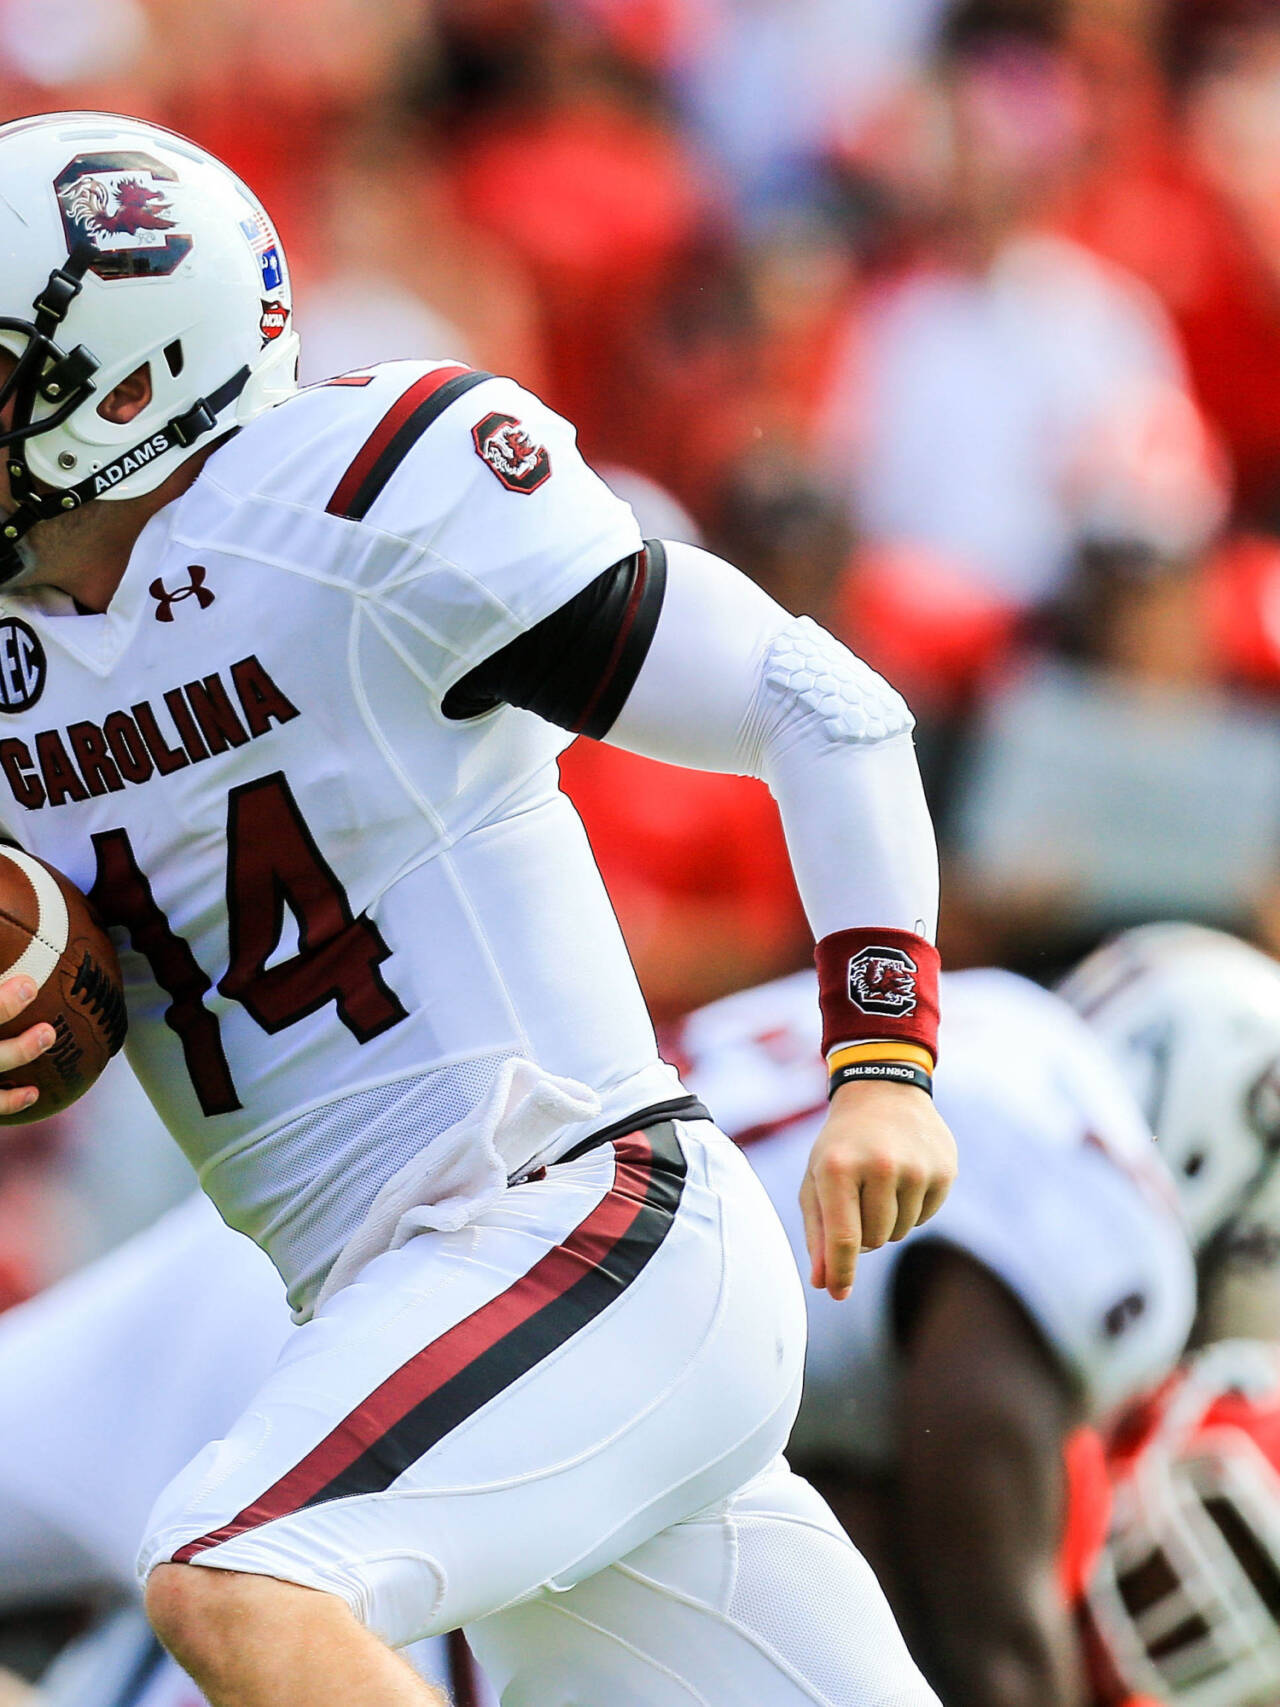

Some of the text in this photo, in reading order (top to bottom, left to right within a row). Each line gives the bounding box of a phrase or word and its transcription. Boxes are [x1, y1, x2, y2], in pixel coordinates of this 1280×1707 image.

[94, 434, 169, 493] ADAMS
[86, 770, 410, 1118] 14
[843, 1066, 915, 1079] BORN FOR THIS
